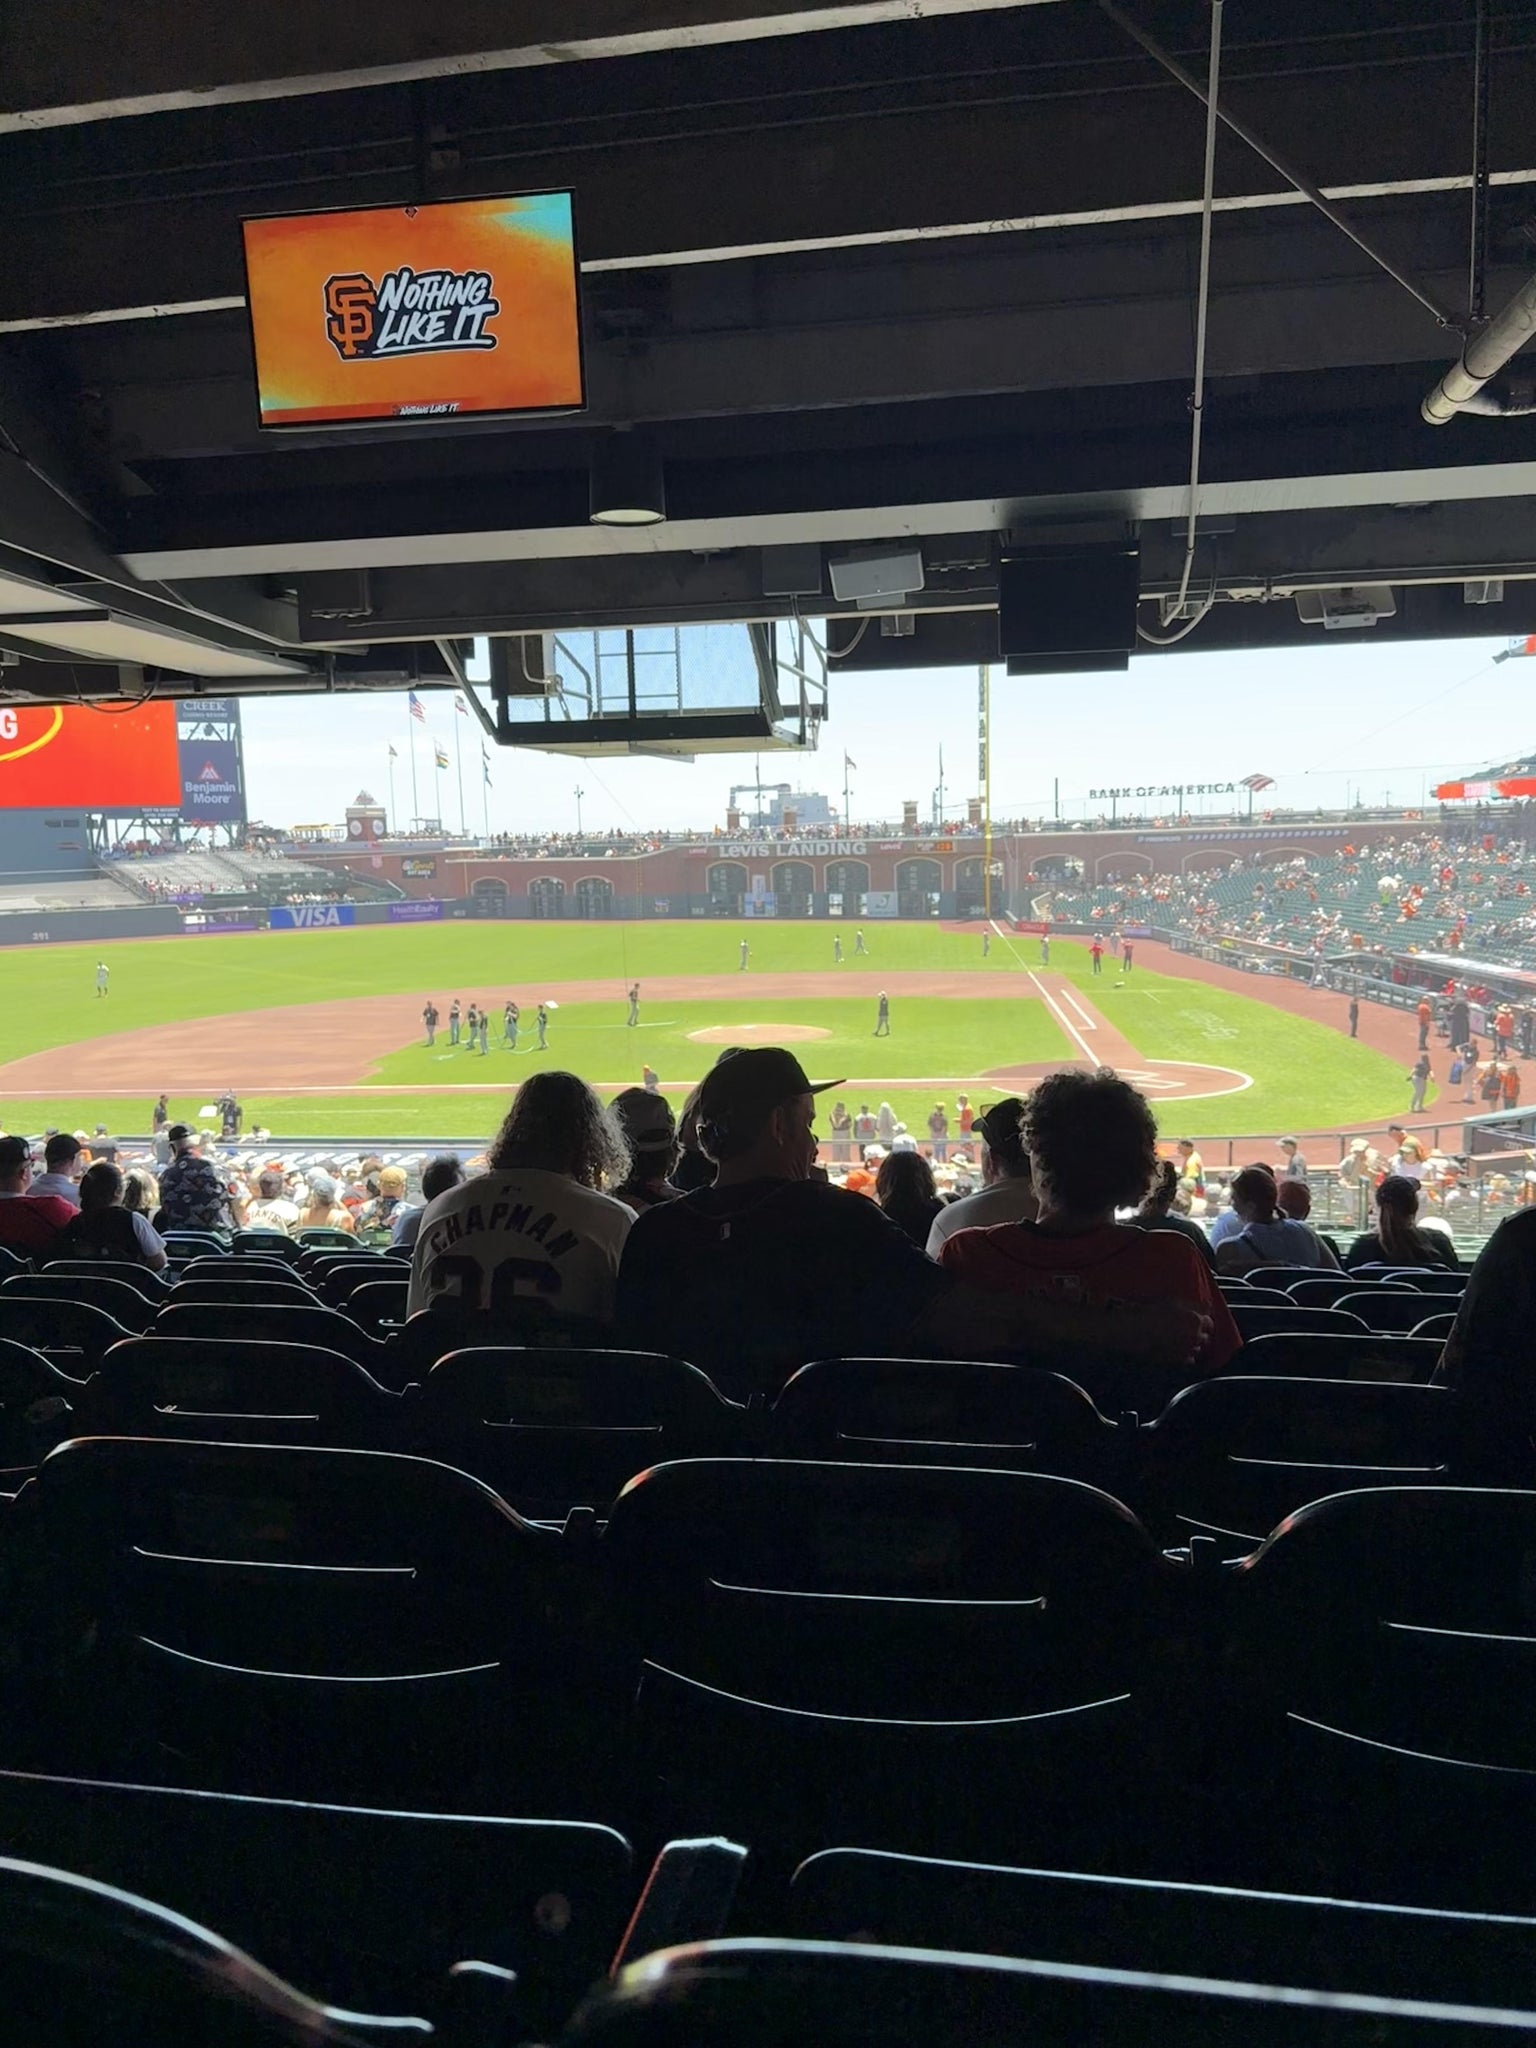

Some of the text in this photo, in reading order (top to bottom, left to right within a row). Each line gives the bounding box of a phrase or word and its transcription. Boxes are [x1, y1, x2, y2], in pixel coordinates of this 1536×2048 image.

[378, 271, 490, 313] NOTHING
[327, 277, 377, 355] SF
[376, 303, 496, 349] LIKE IT
[183, 701, 227, 712] CREEK
[0, 708, 18, 739] G
[184, 781, 236, 795] Benjamin
[193, 793, 230, 804] Moore
[1089, 783, 1235, 799] BANK OF AMERICA
[776, 842, 867, 857] LANDING
[290, 907, 340, 928] VISA
[430, 1202, 579, 1259] CHAPMAN
